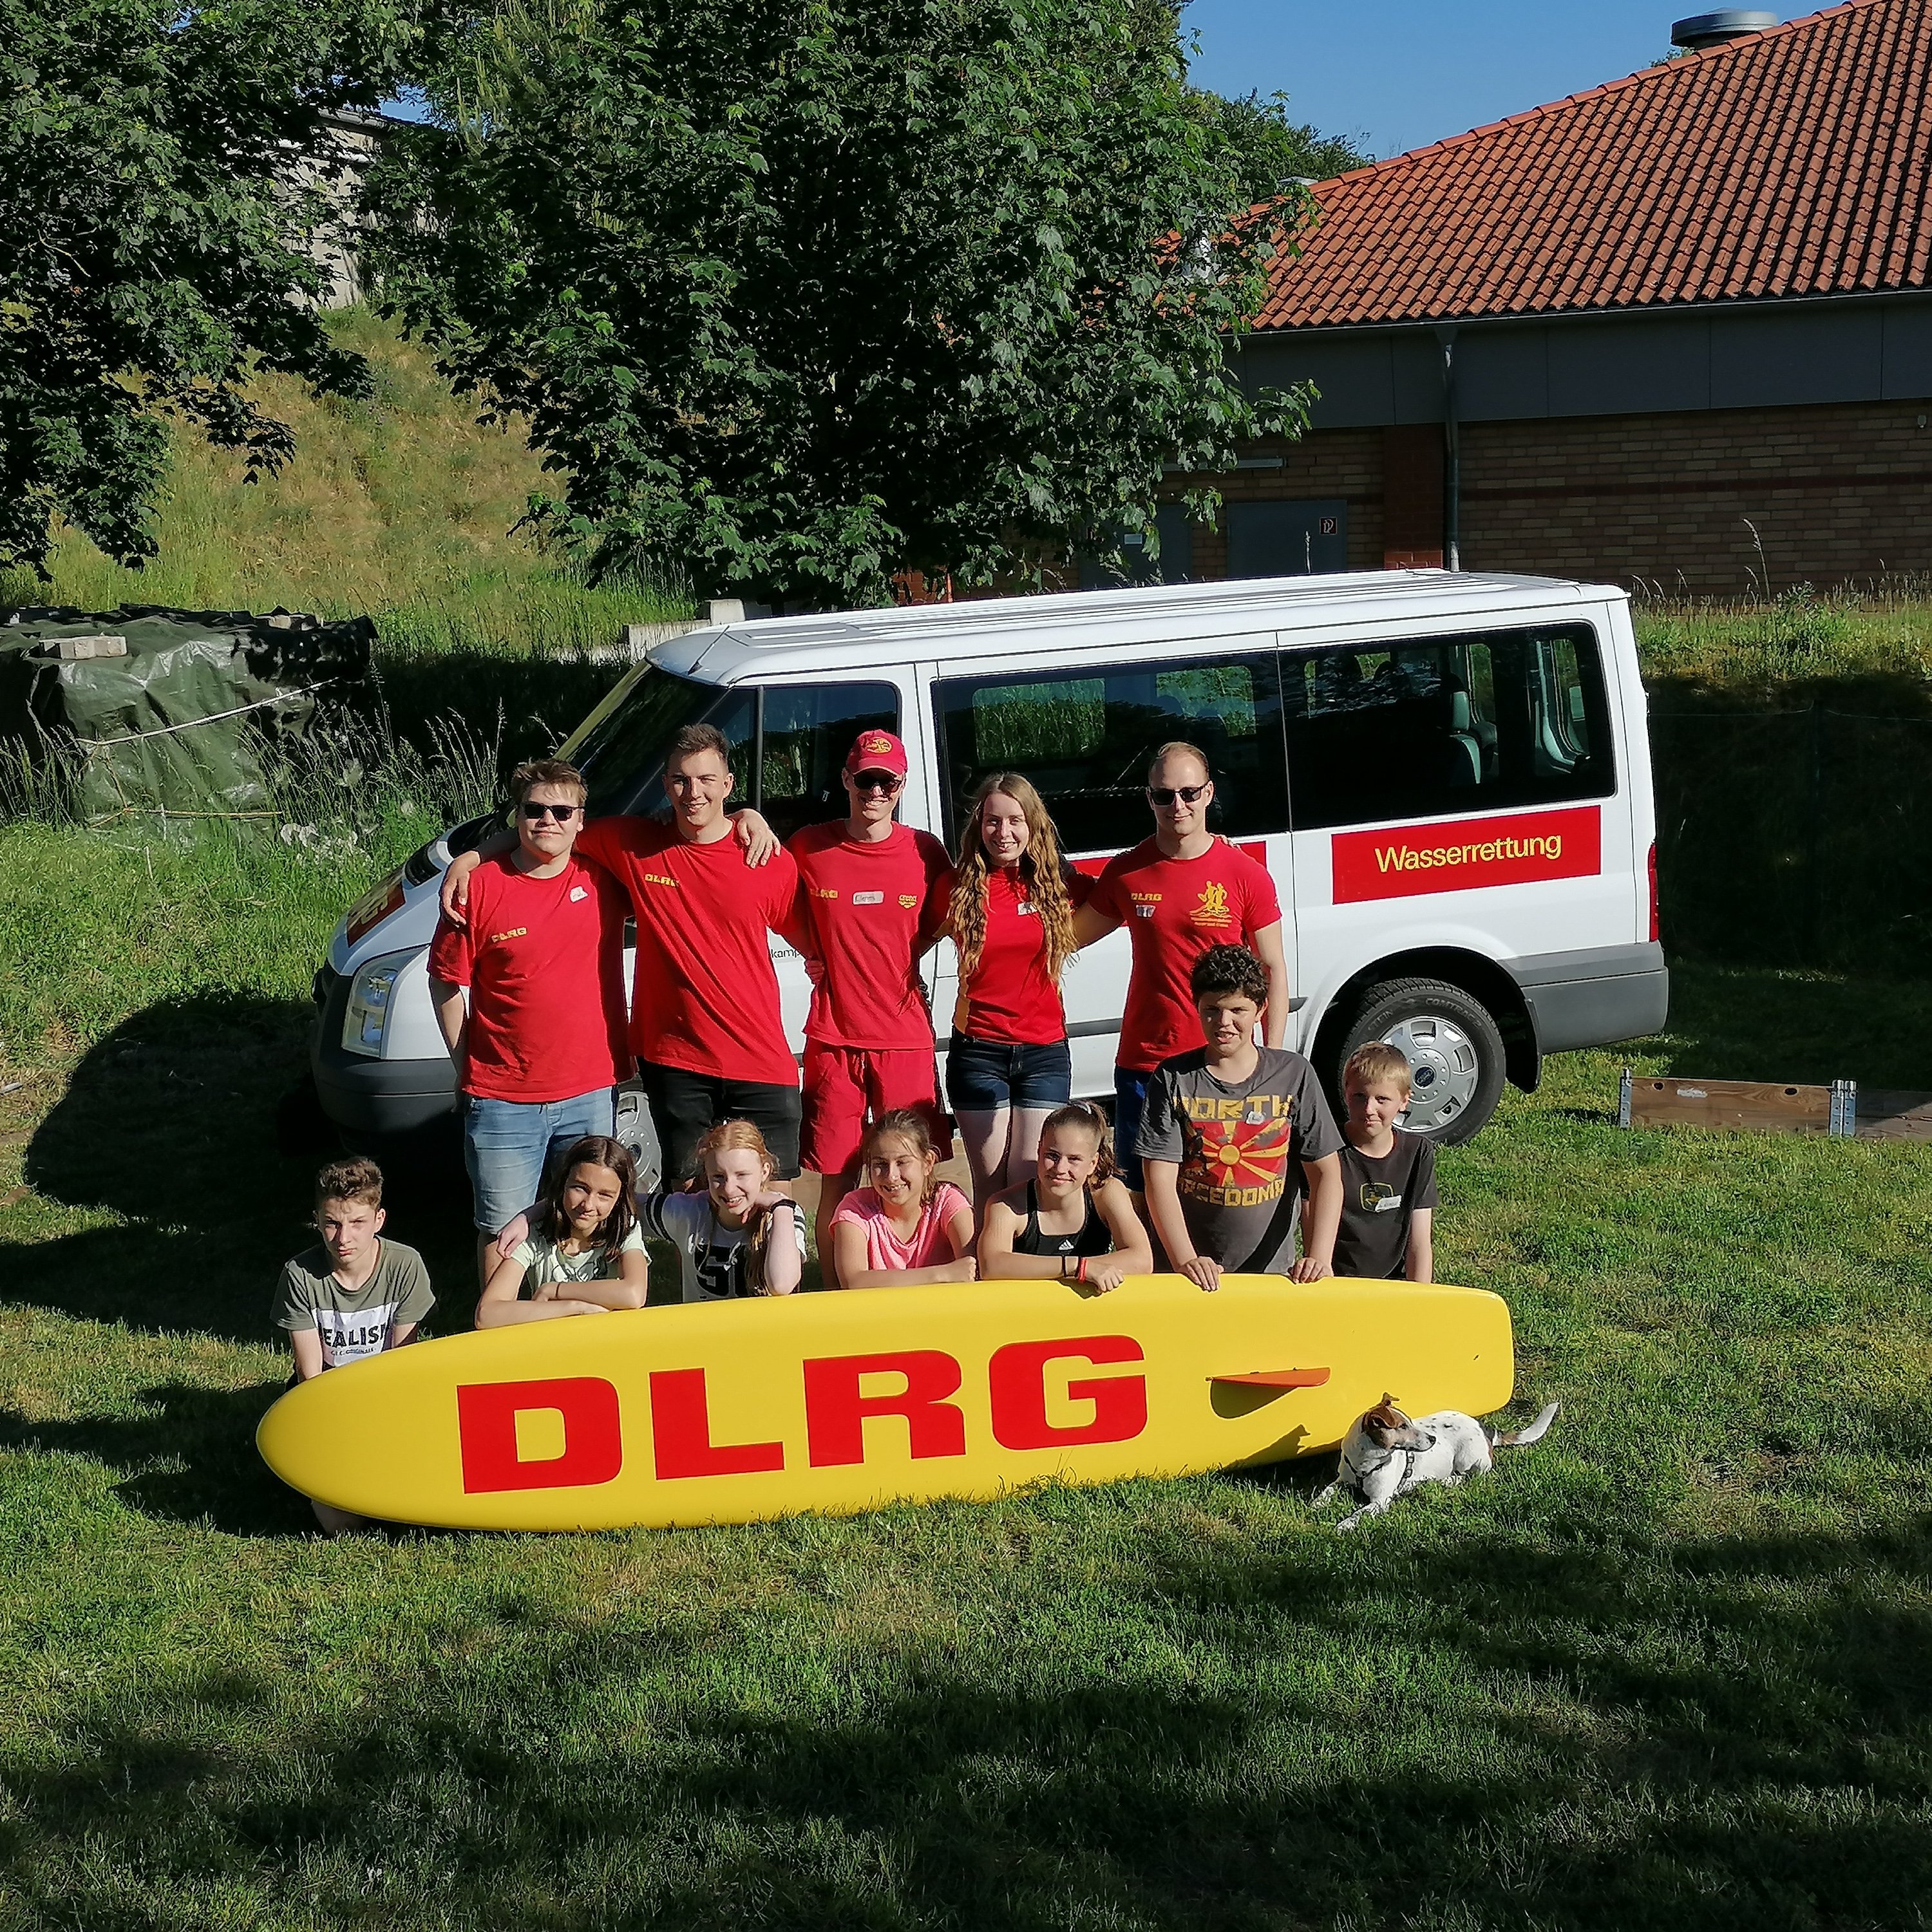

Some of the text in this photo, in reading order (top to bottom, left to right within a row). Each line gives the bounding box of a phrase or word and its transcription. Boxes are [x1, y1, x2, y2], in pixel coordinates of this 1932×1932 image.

[1375, 835, 1561, 872] Wasserrettung
[1131, 893, 1162, 901] DLRG
[1173, 1094, 1292, 1119] NORTH
[457, 1335, 1148, 1494] DLRG
